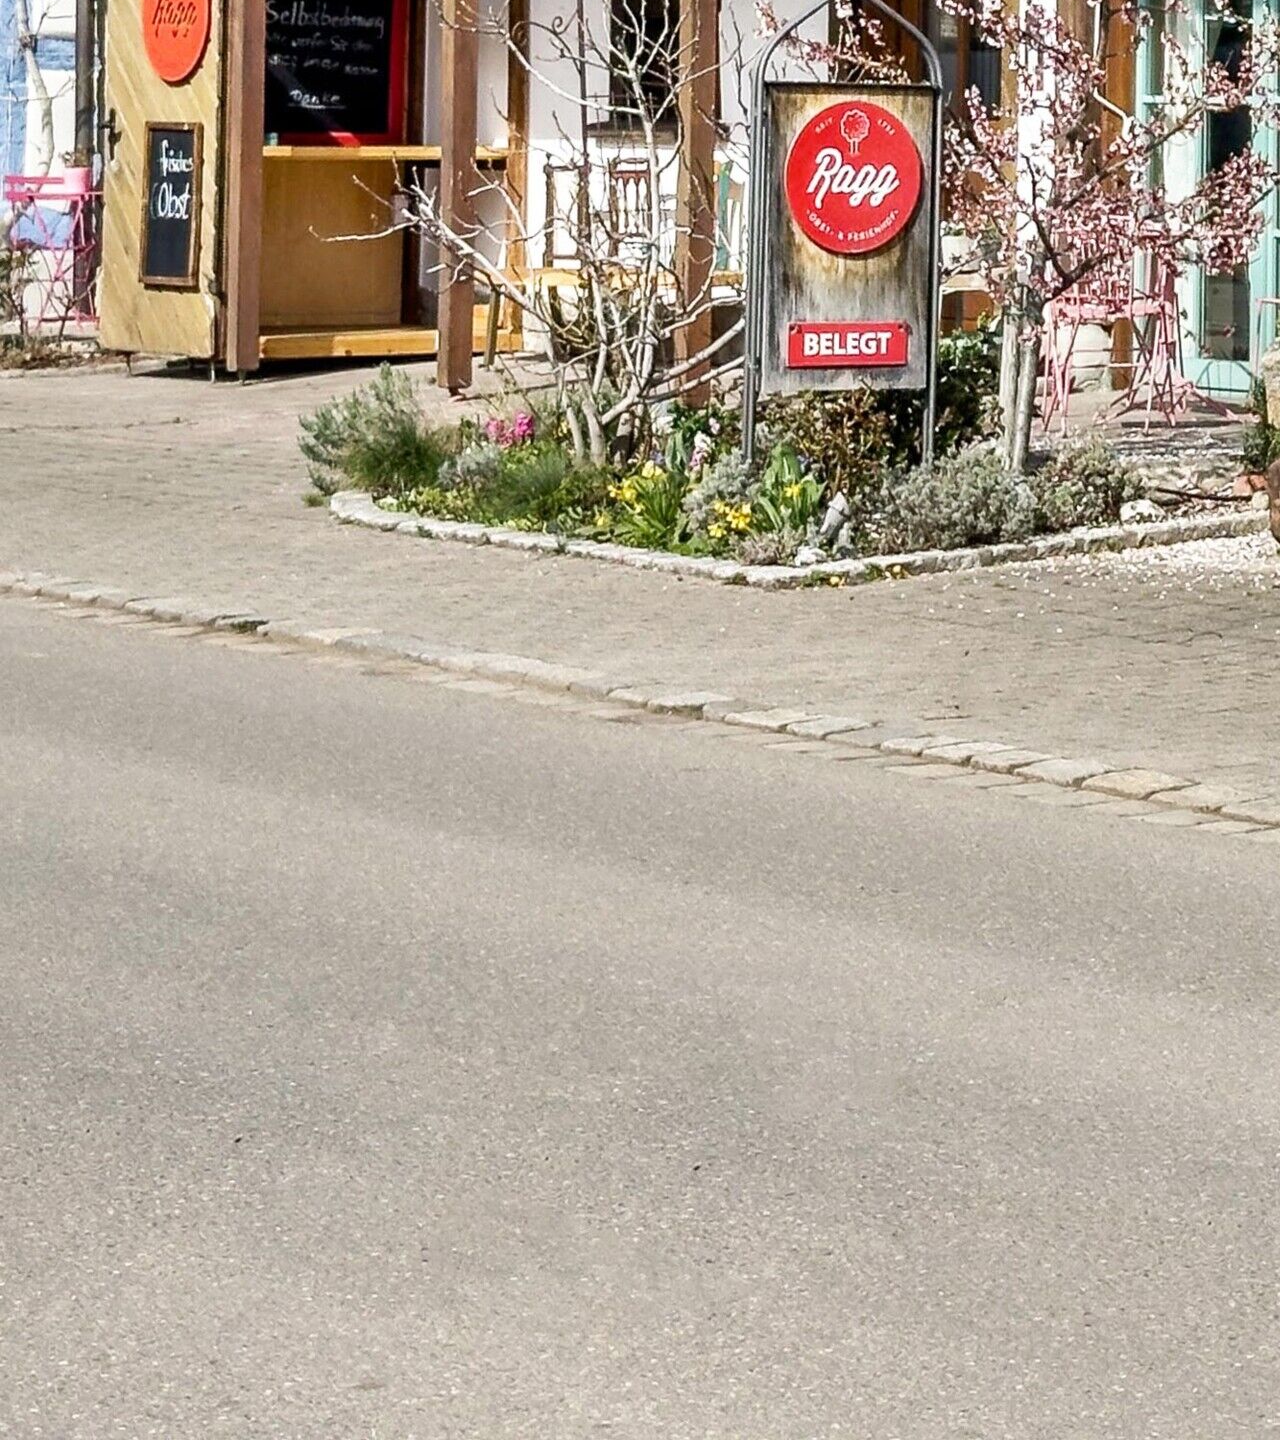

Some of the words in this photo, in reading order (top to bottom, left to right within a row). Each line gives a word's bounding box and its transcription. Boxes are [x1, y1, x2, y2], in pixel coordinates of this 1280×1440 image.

[806, 146, 900, 209] Ragg
[156, 182, 191, 219] Obst
[803, 331, 893, 356] BELEGT
